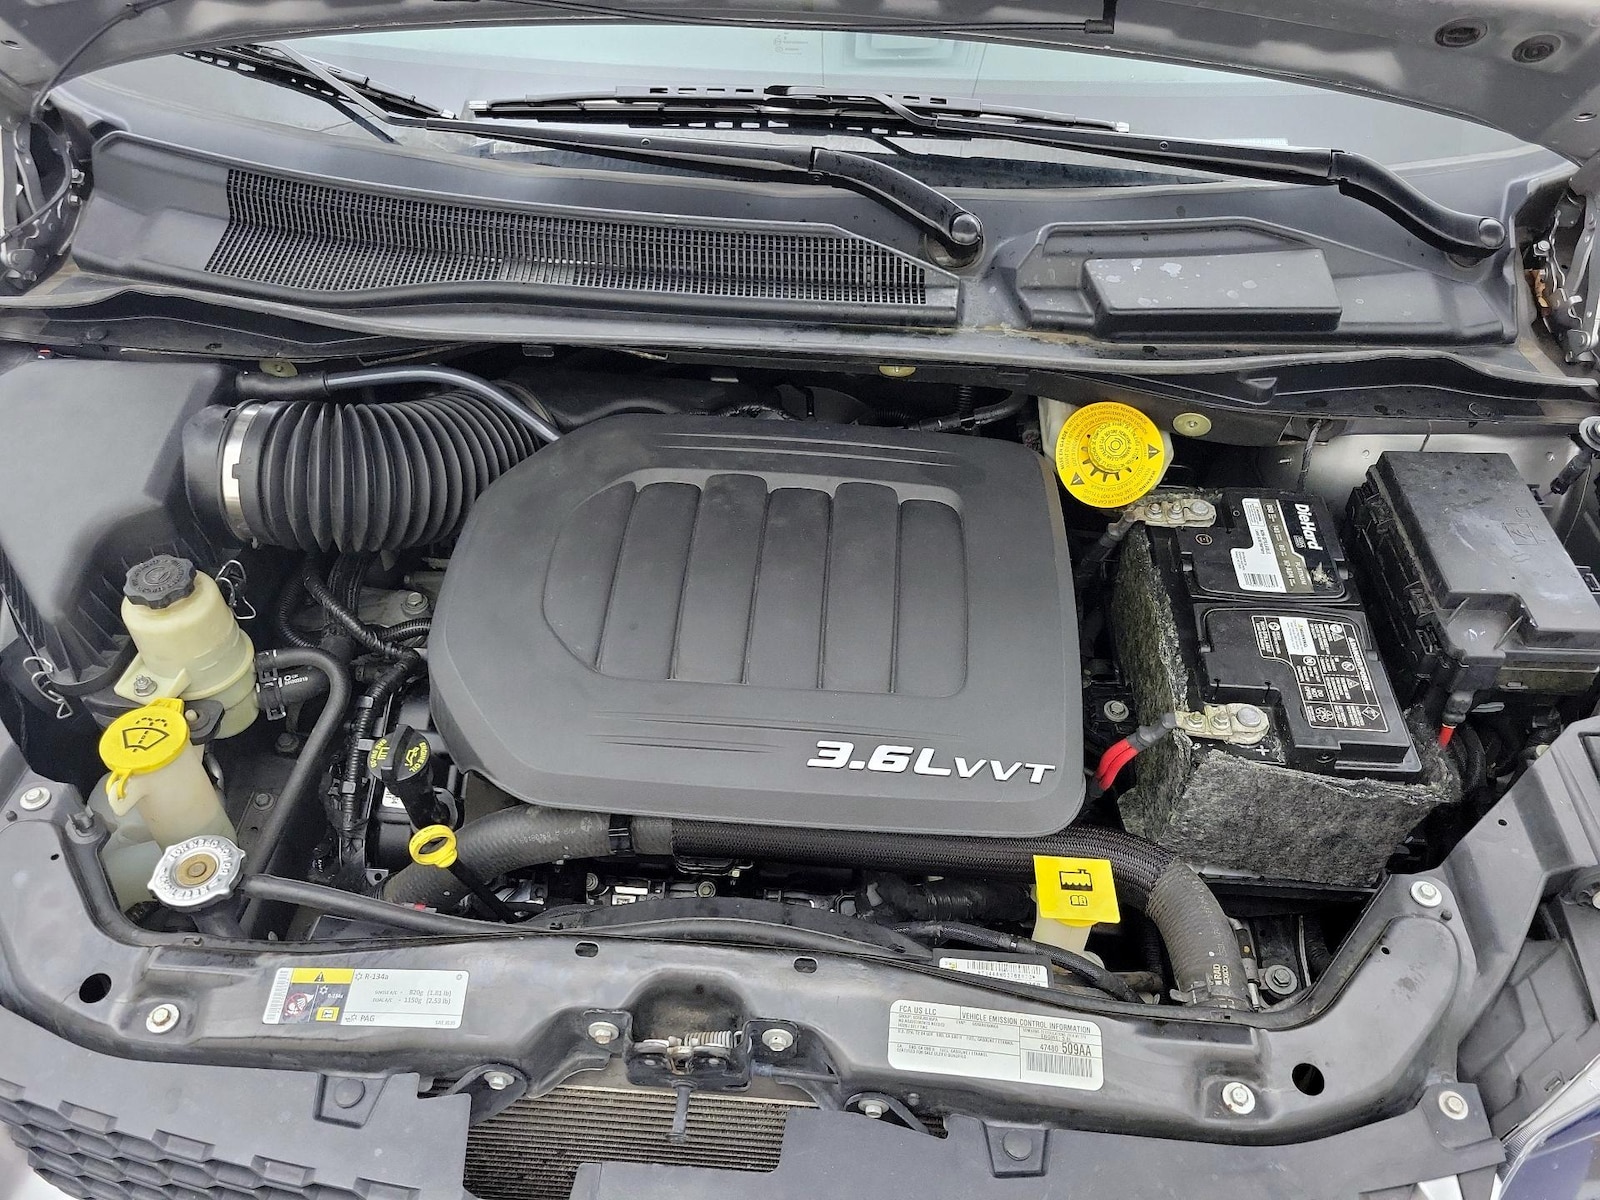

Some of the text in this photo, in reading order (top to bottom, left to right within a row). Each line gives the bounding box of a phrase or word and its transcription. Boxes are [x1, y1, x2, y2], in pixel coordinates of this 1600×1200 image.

[1058, 430, 1068, 447] GARDE
[1294, 503, 1323, 550] DieHard
[1294, 561, 1307, 584] PLATINUM
[1309, 687, 1318, 698] NOT
[1316, 689, 1324, 697] DO
[409, 742, 428, 773] ENGINE OIL
[807, 740, 1056, 784] 3.6L VVT
[168, 844, 189, 861] HOT
[189, 839, 219, 849] OPEN
[178, 886, 209, 899] KEEP
[1212, 963, 1222, 980] RAD
[899, 1005, 912, 1013] FCA
[962, 1012, 988, 1022] VEHICLE
[988, 1015, 1018, 1025] EMISSION
[1020, 1018, 1047, 1029] CONTROL
[1049, 1022, 1091, 1034] INFORMATION
[1062, 1042, 1092, 1057] 509AA
